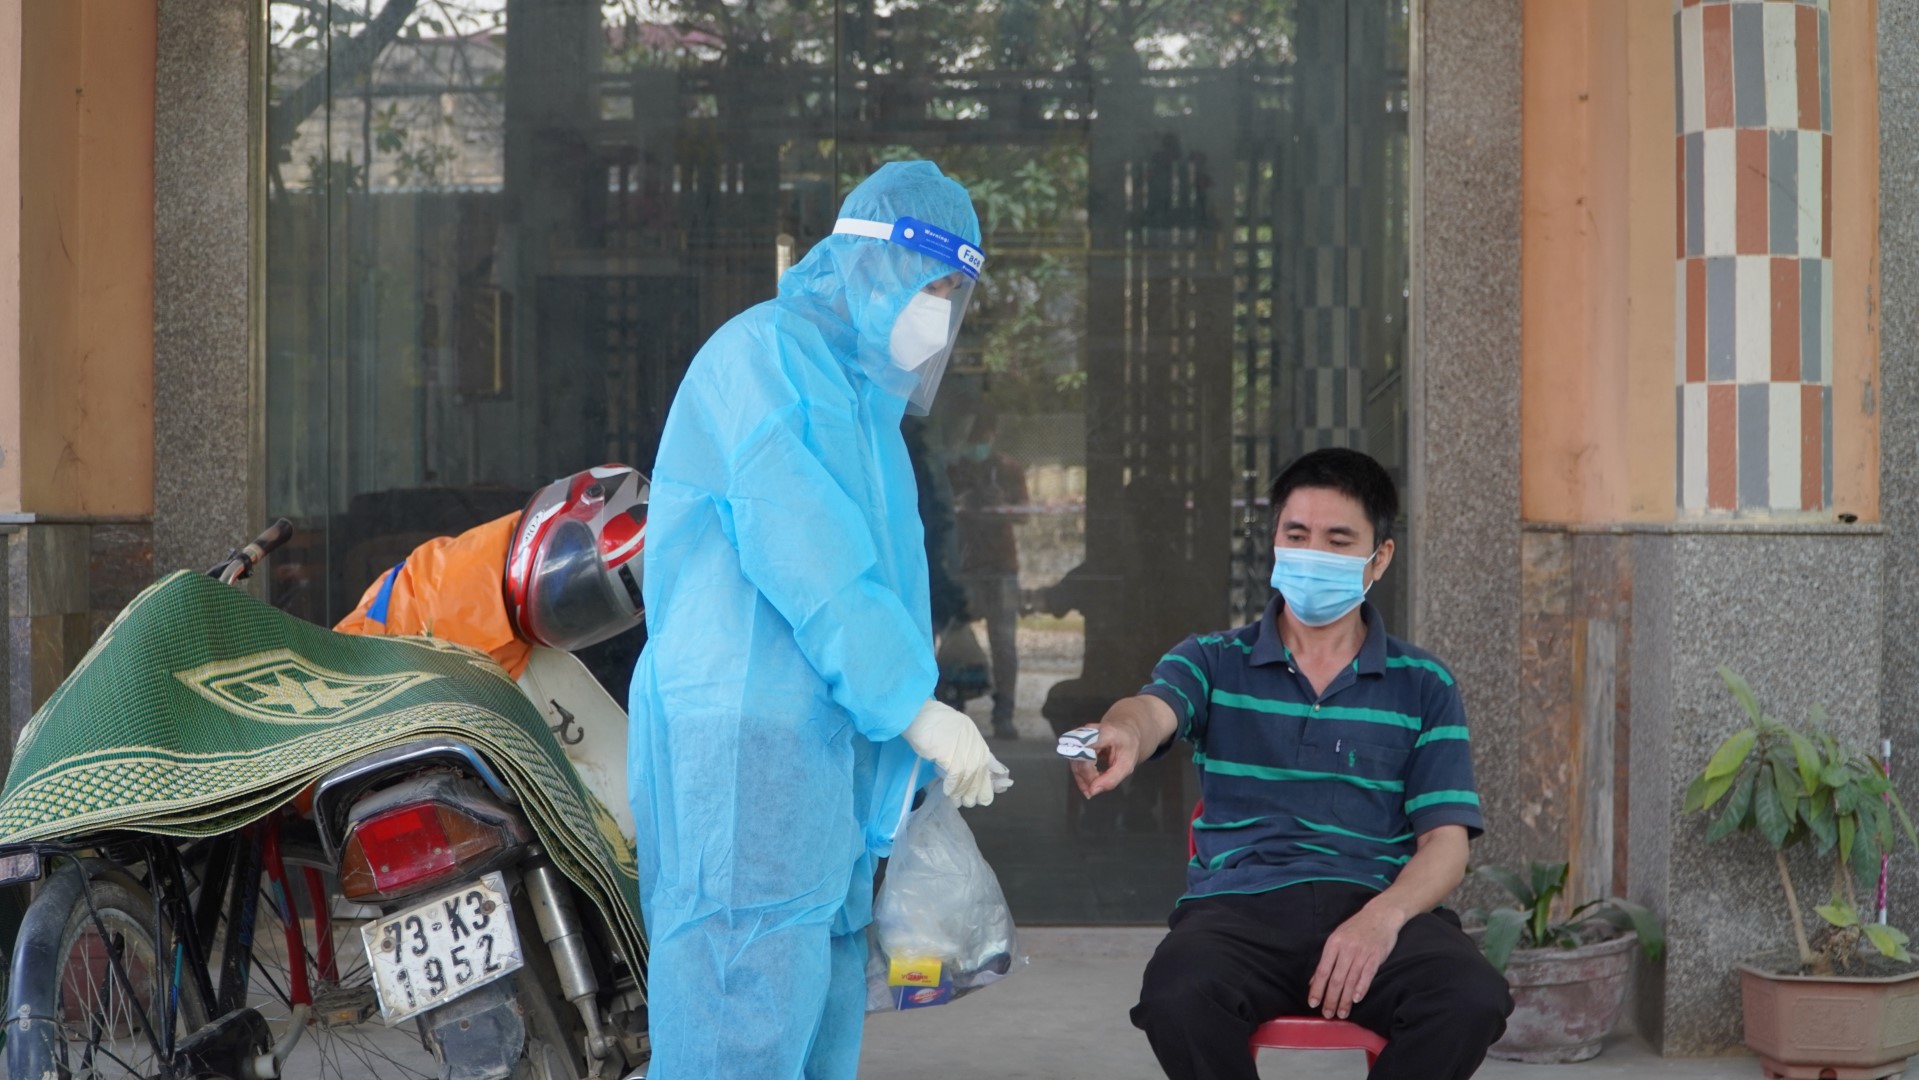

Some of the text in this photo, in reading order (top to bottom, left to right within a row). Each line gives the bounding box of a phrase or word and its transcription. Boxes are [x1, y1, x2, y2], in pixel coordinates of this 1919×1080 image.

[924, 228, 950, 243] Warning:
[963, 249, 982, 268] Face
[397, 933, 501, 1008] 1952
